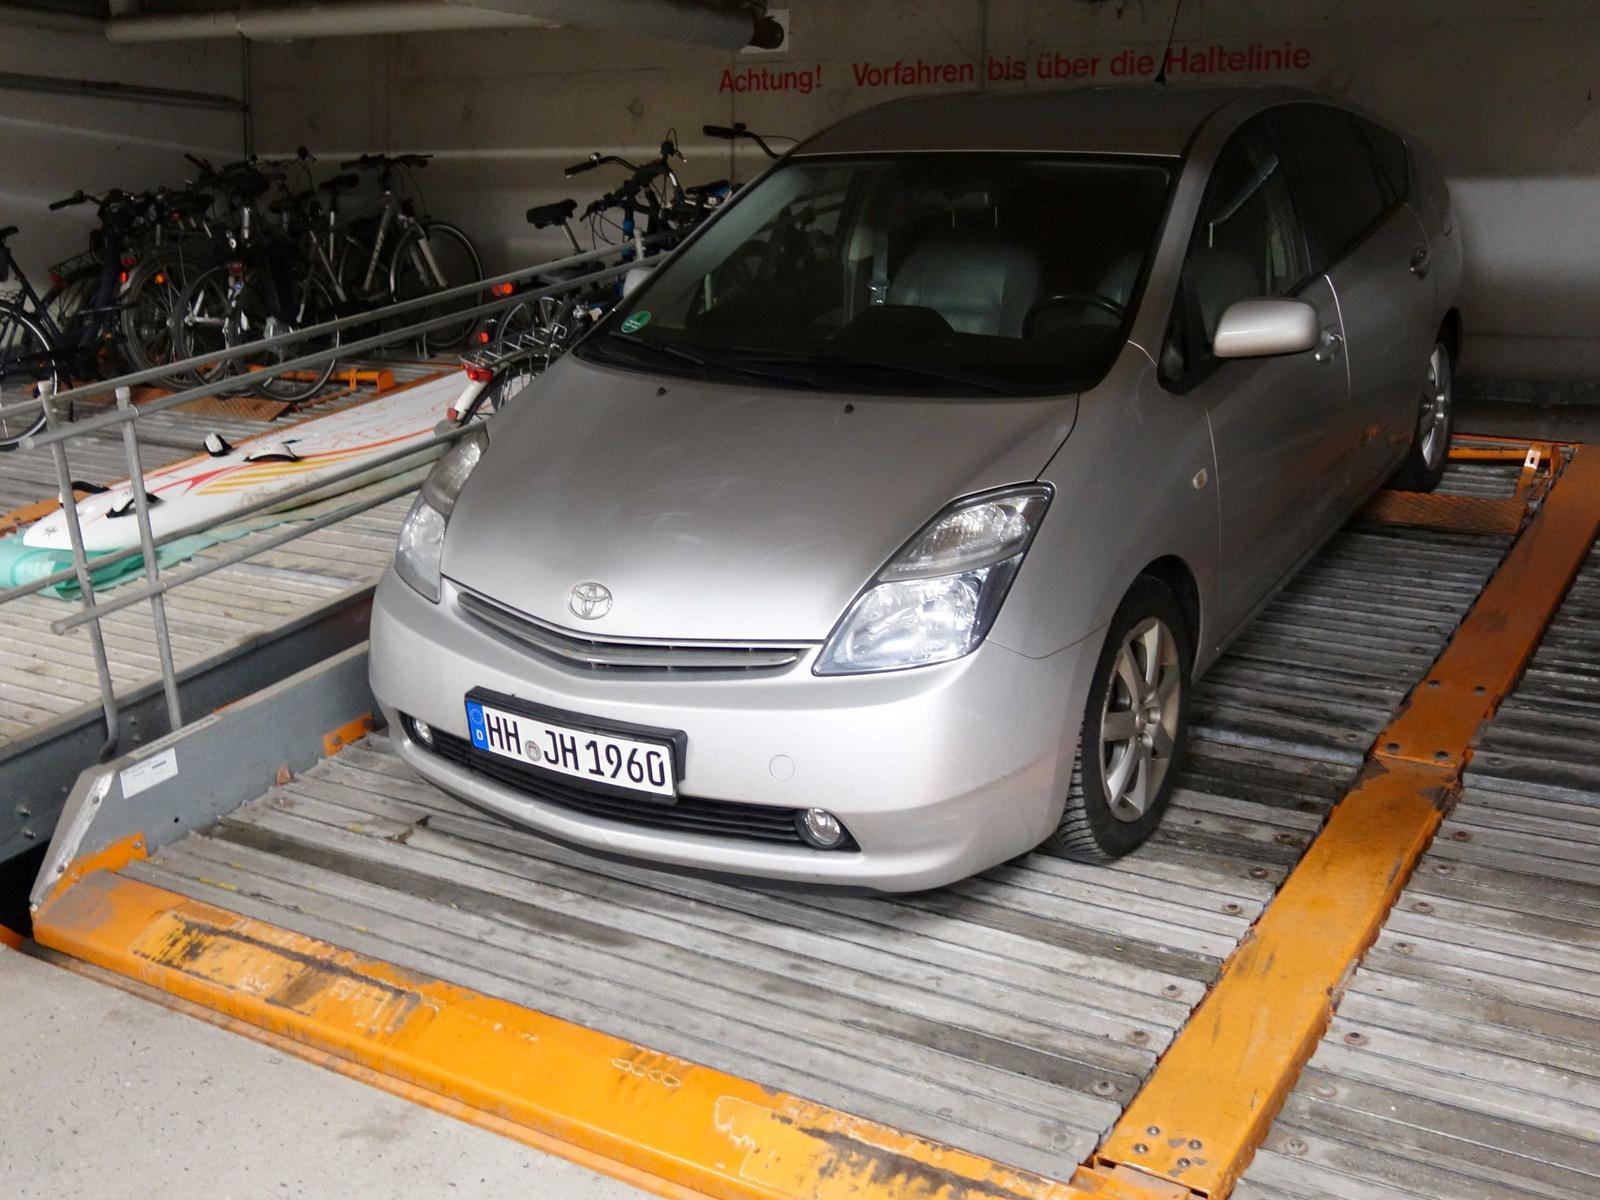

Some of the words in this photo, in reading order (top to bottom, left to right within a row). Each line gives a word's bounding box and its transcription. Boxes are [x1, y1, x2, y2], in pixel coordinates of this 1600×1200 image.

[719, 65, 822, 94] Achtung!
[853, 60, 974, 87] Vorfahren
[987, 55, 1027, 81] bis
[1036, 52, 1101, 80] über
[1110, 49, 1155, 77] die
[1166, 41, 1313, 75] Haltelinie
[476, 728, 484, 741] D
[485, 713, 522, 755] HH
[543, 729, 580, 771] JH
[585, 739, 666, 787] 1960
